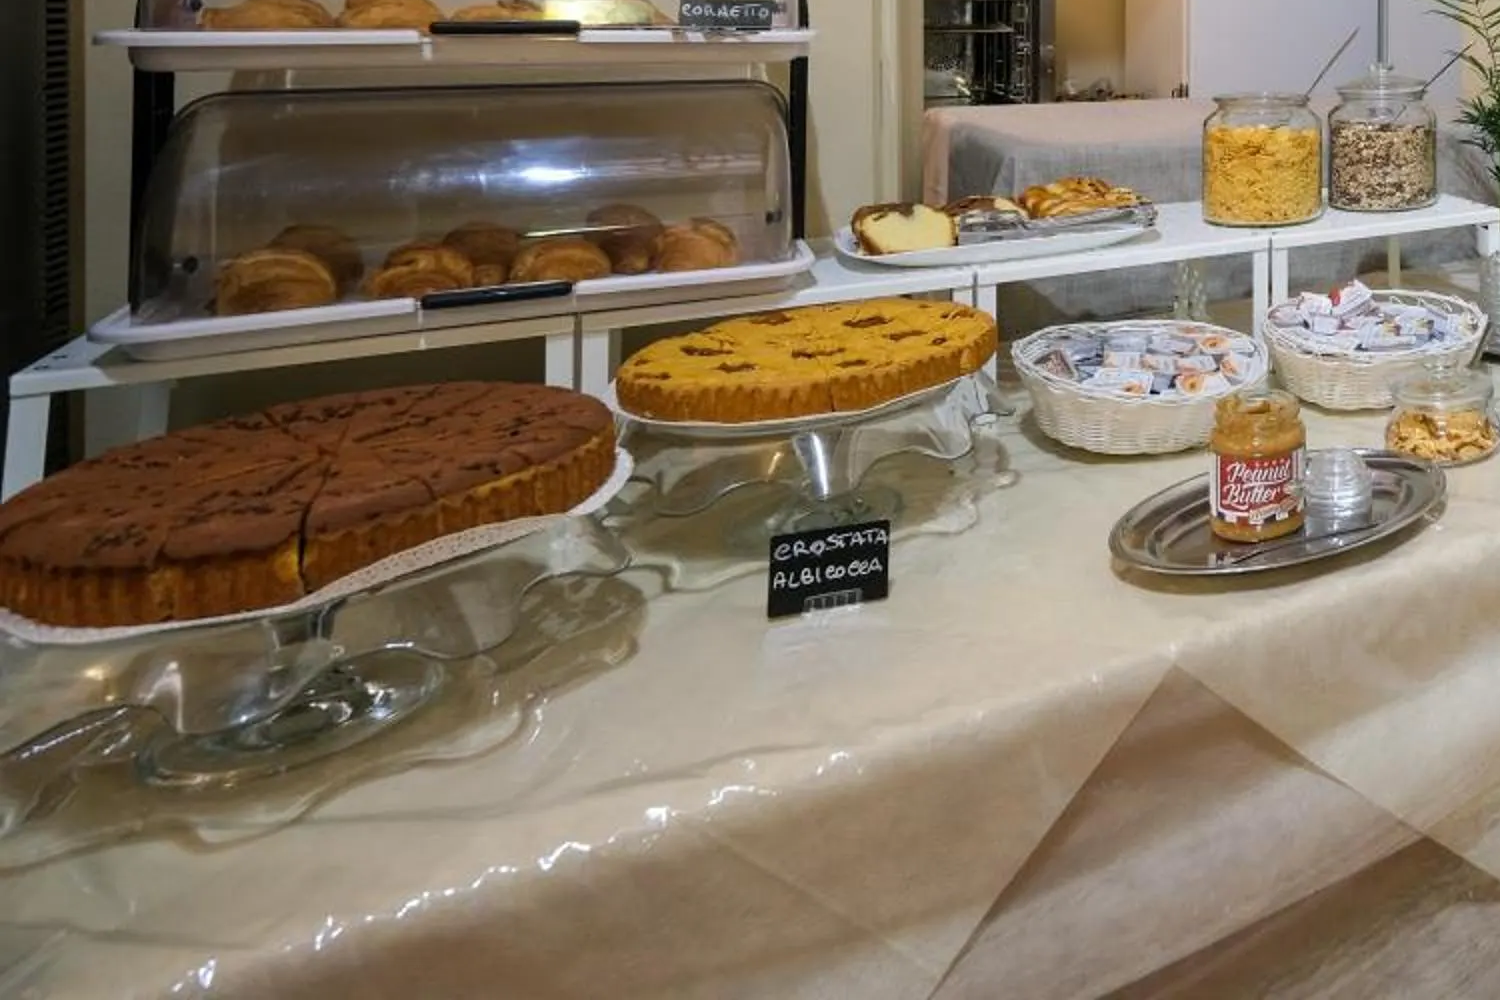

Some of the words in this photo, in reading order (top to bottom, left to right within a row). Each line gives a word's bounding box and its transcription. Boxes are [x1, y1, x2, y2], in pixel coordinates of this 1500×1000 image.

[1226, 459, 1291, 484] Peanut
[1222, 484, 1281, 510] Butter
[773, 528, 888, 561] CROSTATA
[772, 557, 883, 590] ALBICOCCA
